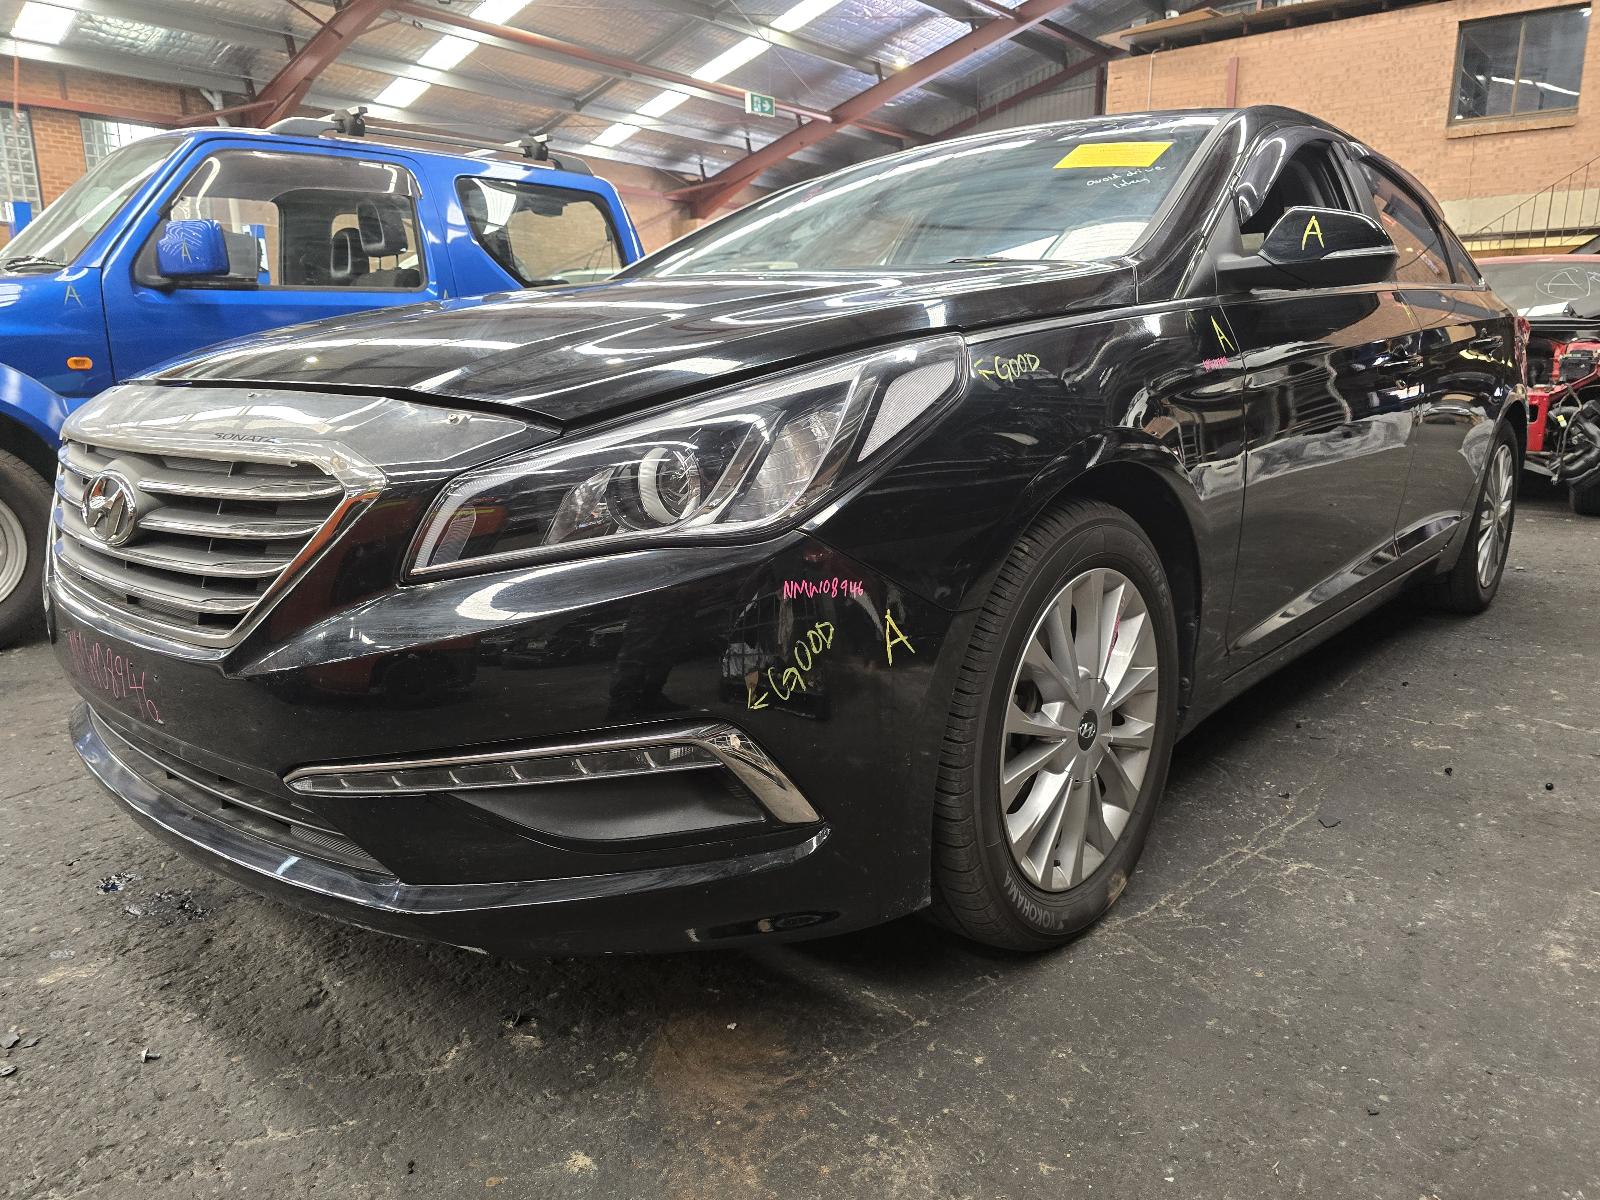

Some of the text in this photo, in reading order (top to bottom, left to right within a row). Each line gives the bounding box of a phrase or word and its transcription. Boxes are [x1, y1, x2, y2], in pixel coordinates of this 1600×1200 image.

[1301, 215, 1325, 251] A
[64, 285, 84, 309] A
[1210, 315, 1235, 354] A
[994, 353, 1041, 383] GOOD
[884, 608, 916, 667] A
[768, 621, 835, 701] GOOD
